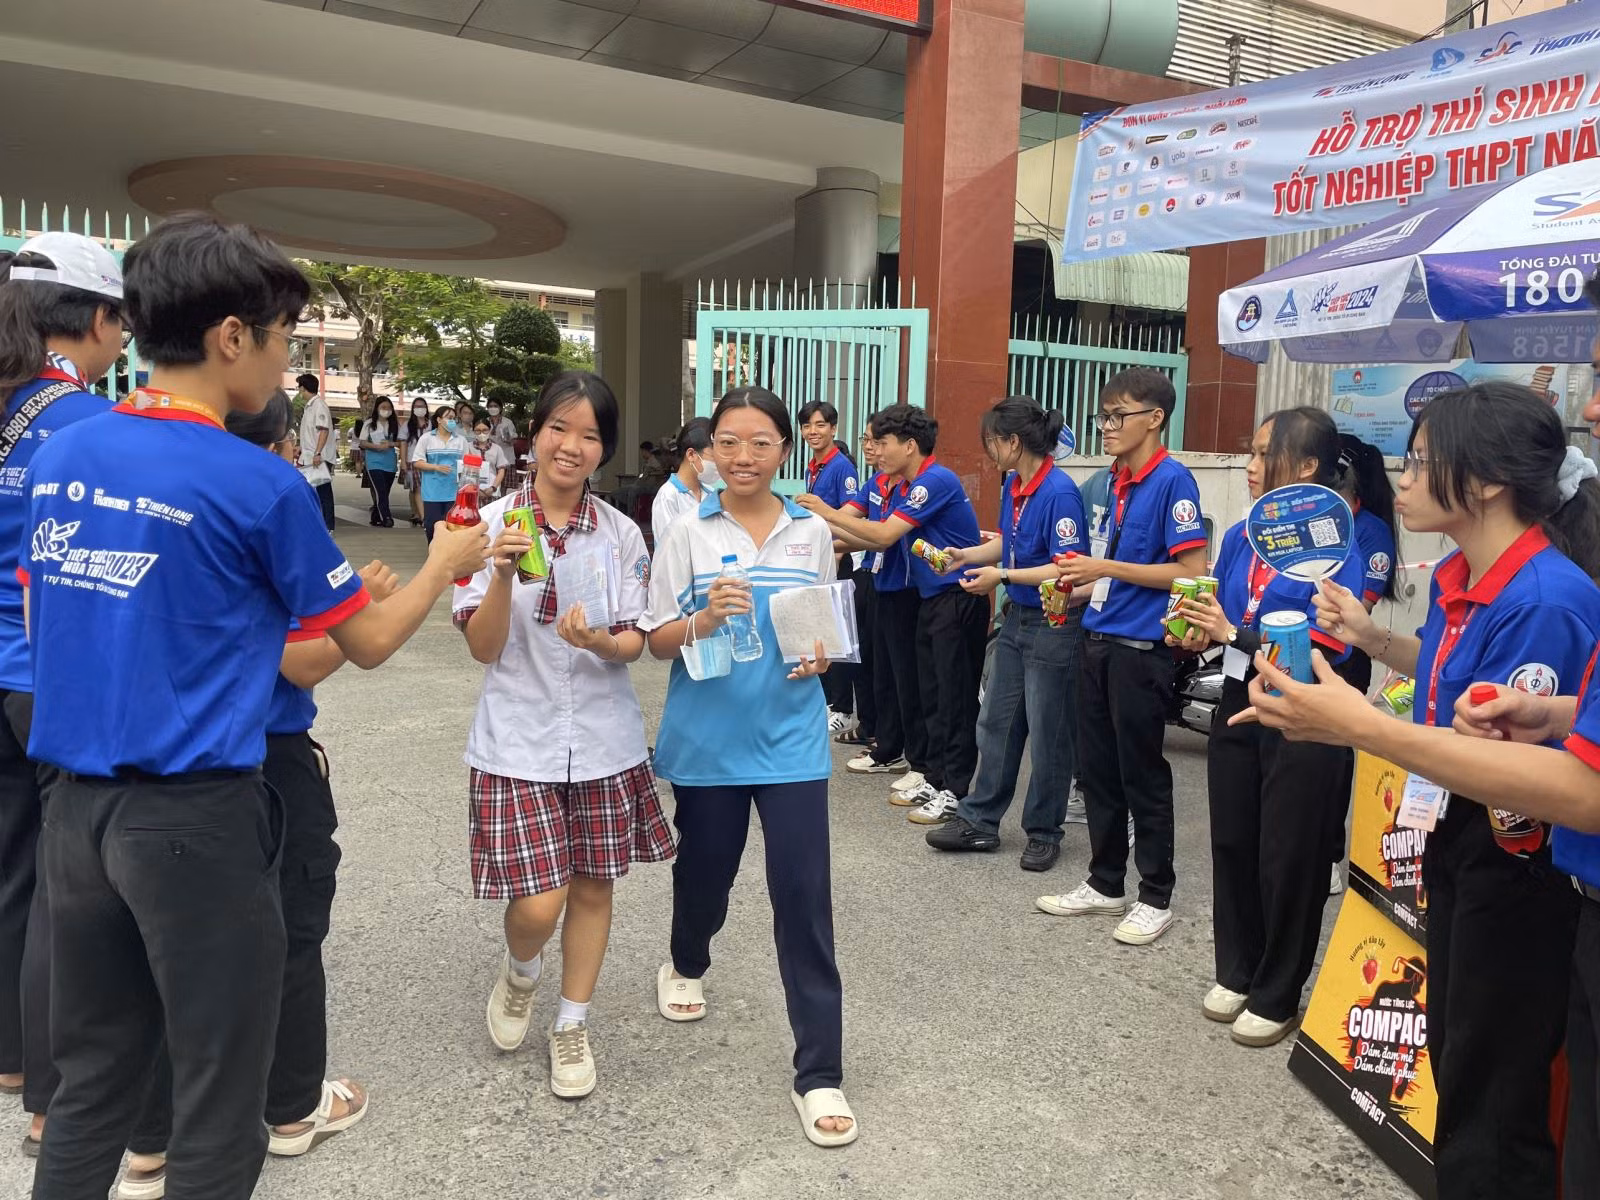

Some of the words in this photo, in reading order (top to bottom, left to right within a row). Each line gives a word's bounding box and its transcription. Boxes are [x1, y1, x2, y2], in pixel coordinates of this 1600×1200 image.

[1308, 108, 1357, 158] HỖ
[1359, 104, 1424, 150] TRỢ
[1428, 84, 1486, 138] THÍ
[1489, 73, 1586, 125] SINH
[1272, 165, 1319, 216] TỐT
[1323, 151, 1436, 206] NGHIỆP
[1446, 136, 1534, 190] THPT
[1499, 256, 1544, 271] TỔNG
[1499, 267, 1598, 308] 180
[169, 507, 194, 522] LONG
[1264, 535, 1276, 550] 3
[66, 548, 90, 562] TIẾP
[105, 552, 152, 582] 2023
[1348, 1006, 1427, 1047] COMPAC
[1354, 1056, 1374, 1073] Dám
[1361, 1041, 1381, 1058] Dám
[1400, 1048, 1414, 1063] mê
